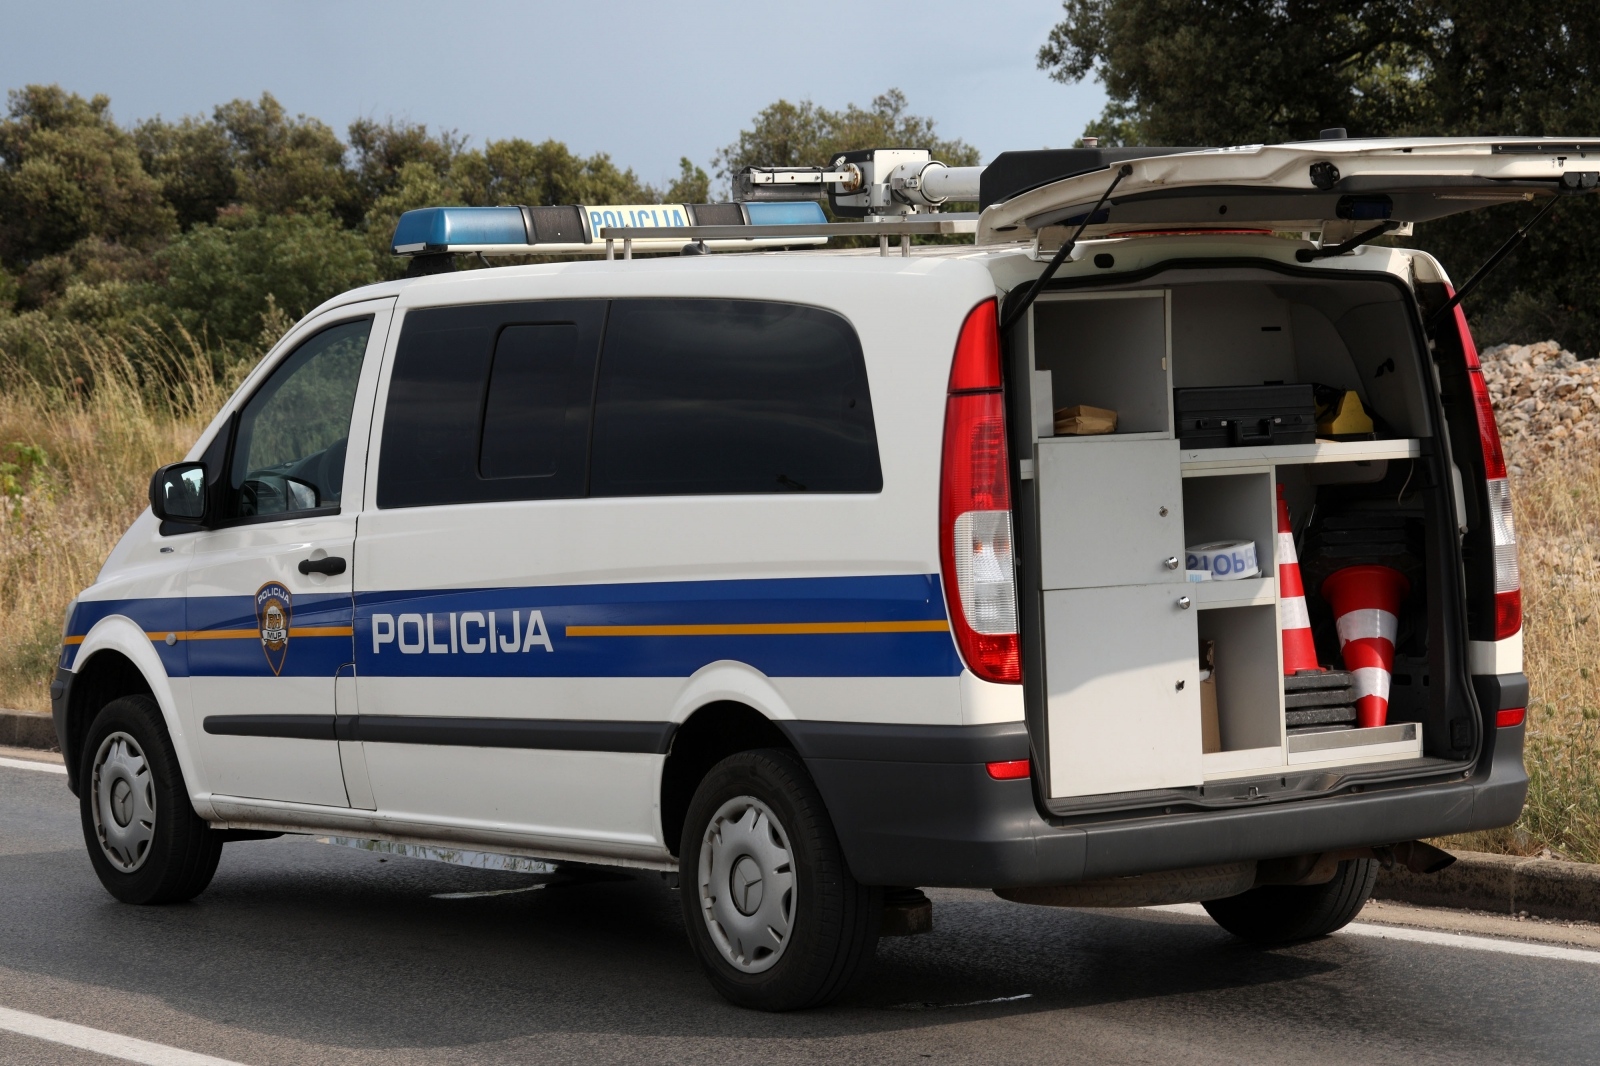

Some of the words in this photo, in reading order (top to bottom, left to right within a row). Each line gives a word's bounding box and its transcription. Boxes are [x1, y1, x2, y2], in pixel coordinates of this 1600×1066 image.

[257, 587, 290, 605] POLICIJA
[266, 631, 282, 640] MUP
[372, 610, 554, 654] POLICIJA
